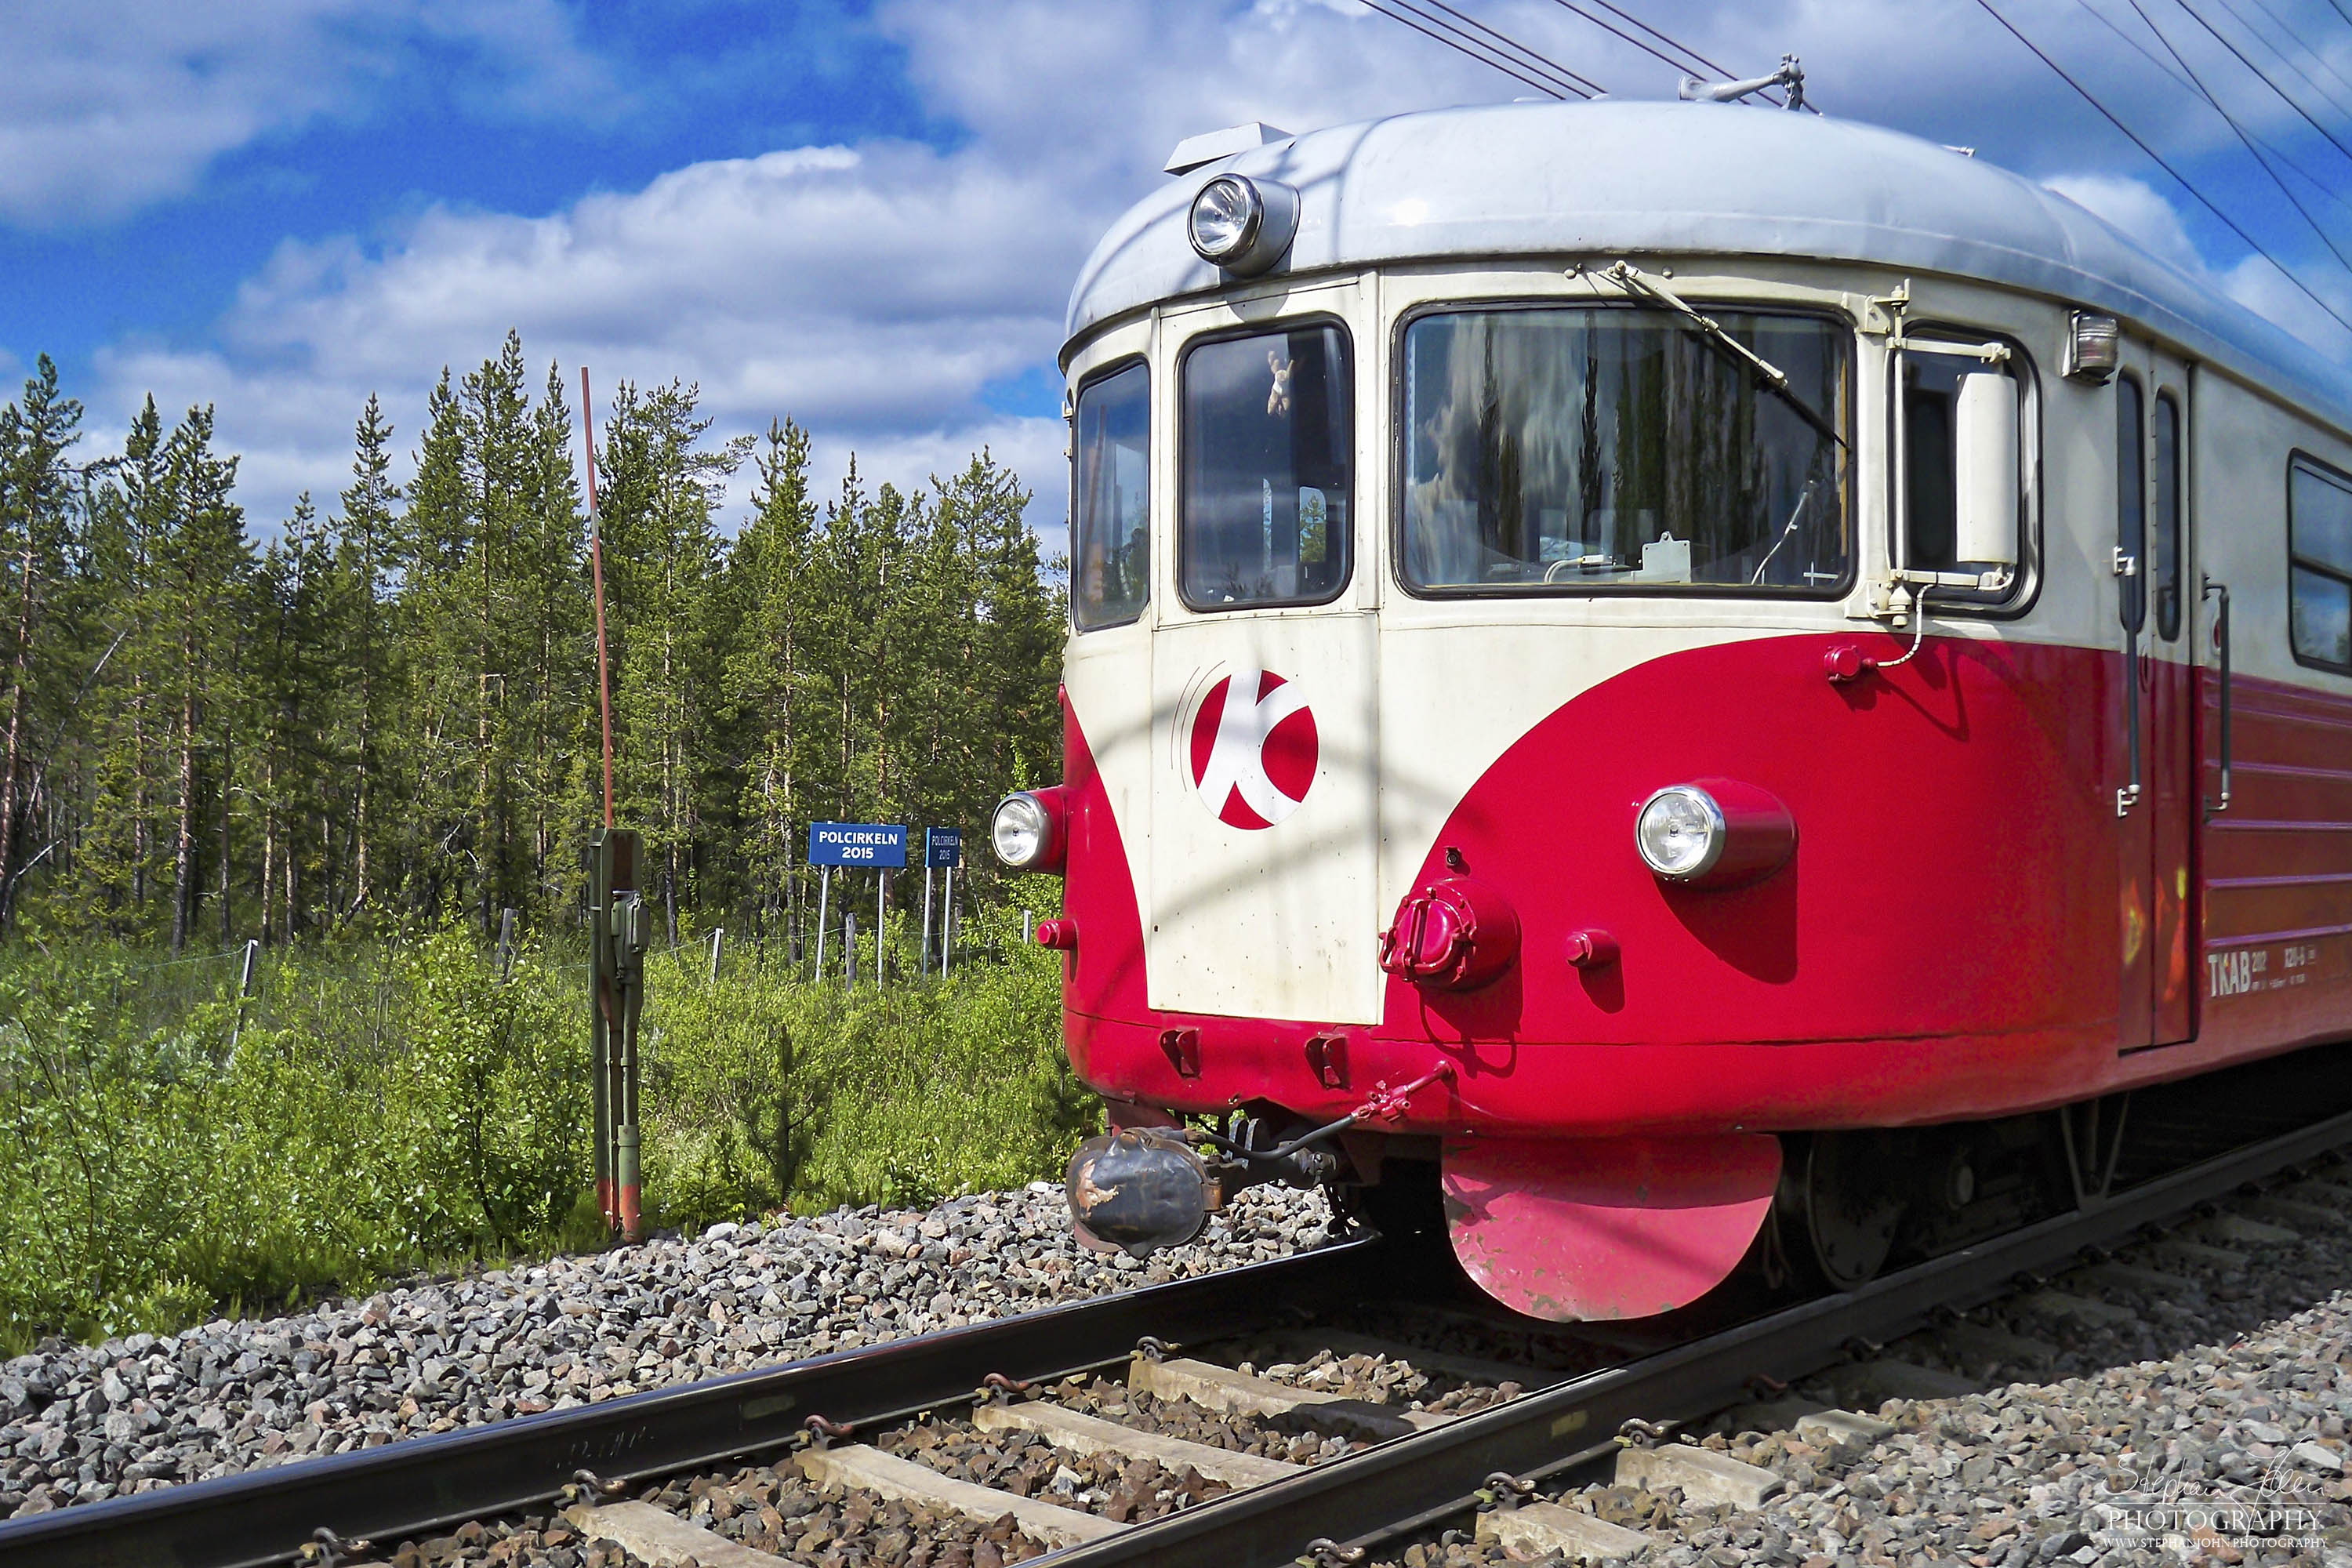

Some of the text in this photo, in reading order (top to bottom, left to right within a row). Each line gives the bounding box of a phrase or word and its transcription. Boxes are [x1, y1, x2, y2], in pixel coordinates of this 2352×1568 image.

[818, 831, 898, 845] POLCIRKELN
[931, 835, 958, 846] POLCIRKELN
[841, 847, 873, 859] 2015
[938, 849, 950, 860] 2015
[2208, 950, 2251, 997] TKAB
